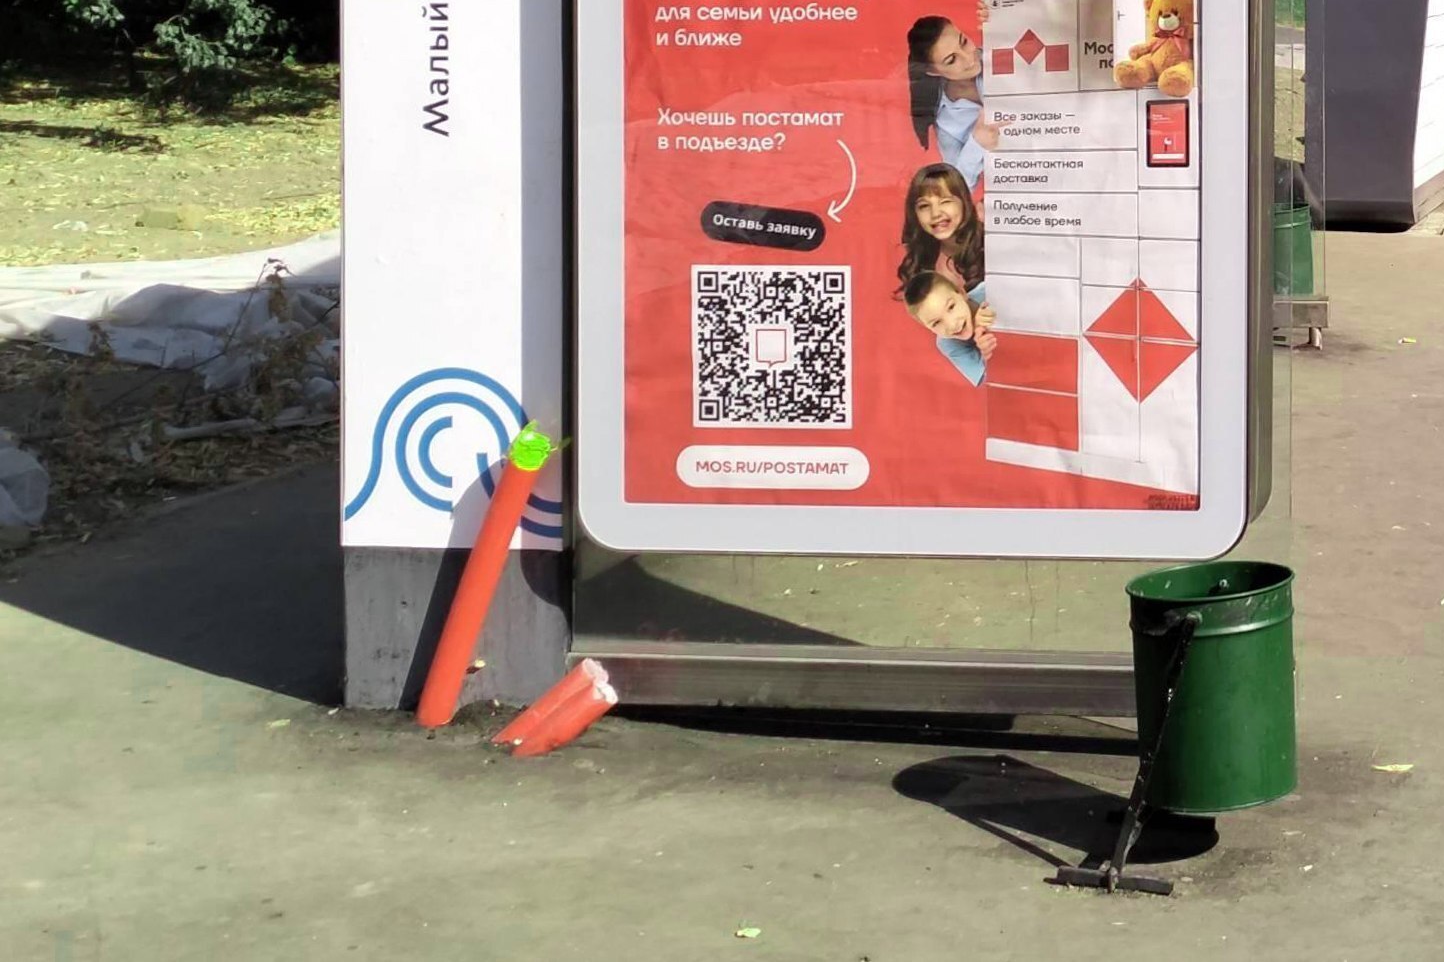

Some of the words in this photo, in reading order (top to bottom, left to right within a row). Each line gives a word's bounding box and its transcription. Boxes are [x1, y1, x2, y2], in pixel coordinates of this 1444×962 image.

[655, 6, 691, 22] для
[697, 5, 762, 20] семьи
[769, 3, 858, 23] удобнее
[656, 32, 669, 46] и
[674, 29, 742, 46] ближе
[422, 2, 449, 137] Малый
[657, 108, 736, 126] Хочешь
[742, 112, 844, 126] постамат
[994, 111, 1017, 122] Все
[1020, 112, 1062, 121] заказы
[1003, 126, 1041, 137] одном
[1045, 125, 1081, 135] месте
[657, 137, 669, 150] в
[675, 132, 786, 153] подъезде?
[994, 158, 1084, 169] Бесконтактная
[993, 174, 1049, 184] доставка
[993, 199, 1058, 213] Получение
[712, 213, 764, 231] Оставь
[766, 221, 817, 240] заявку
[994, 217, 1001, 225] в
[1003, 214, 1041, 226] любое
[1044, 217, 1082, 228] время
[695, 460, 849, 475] MOS.RU/POSTAMAT
